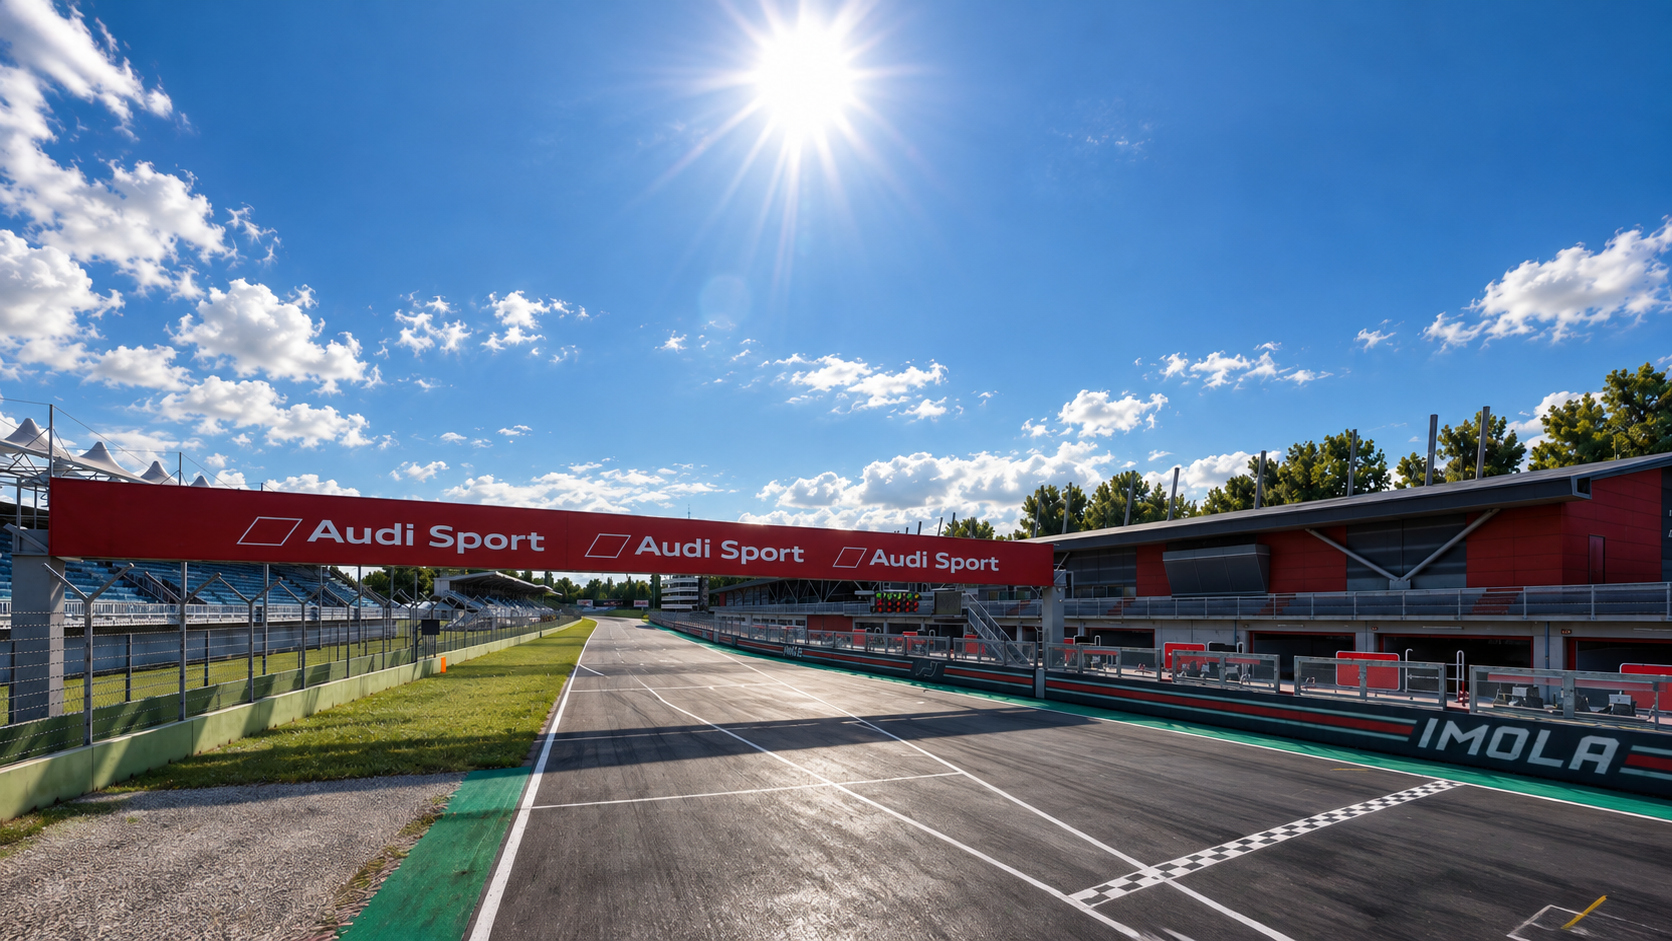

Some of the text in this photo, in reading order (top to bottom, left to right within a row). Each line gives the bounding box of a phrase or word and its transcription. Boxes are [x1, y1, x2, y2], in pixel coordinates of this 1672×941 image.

[306, 519, 545, 554] Audi Sport
[634, 535, 805, 565] Audi Sport
[869, 548, 1000, 574] Audi Sport
[1417, 717, 1620, 775] IMOLA
